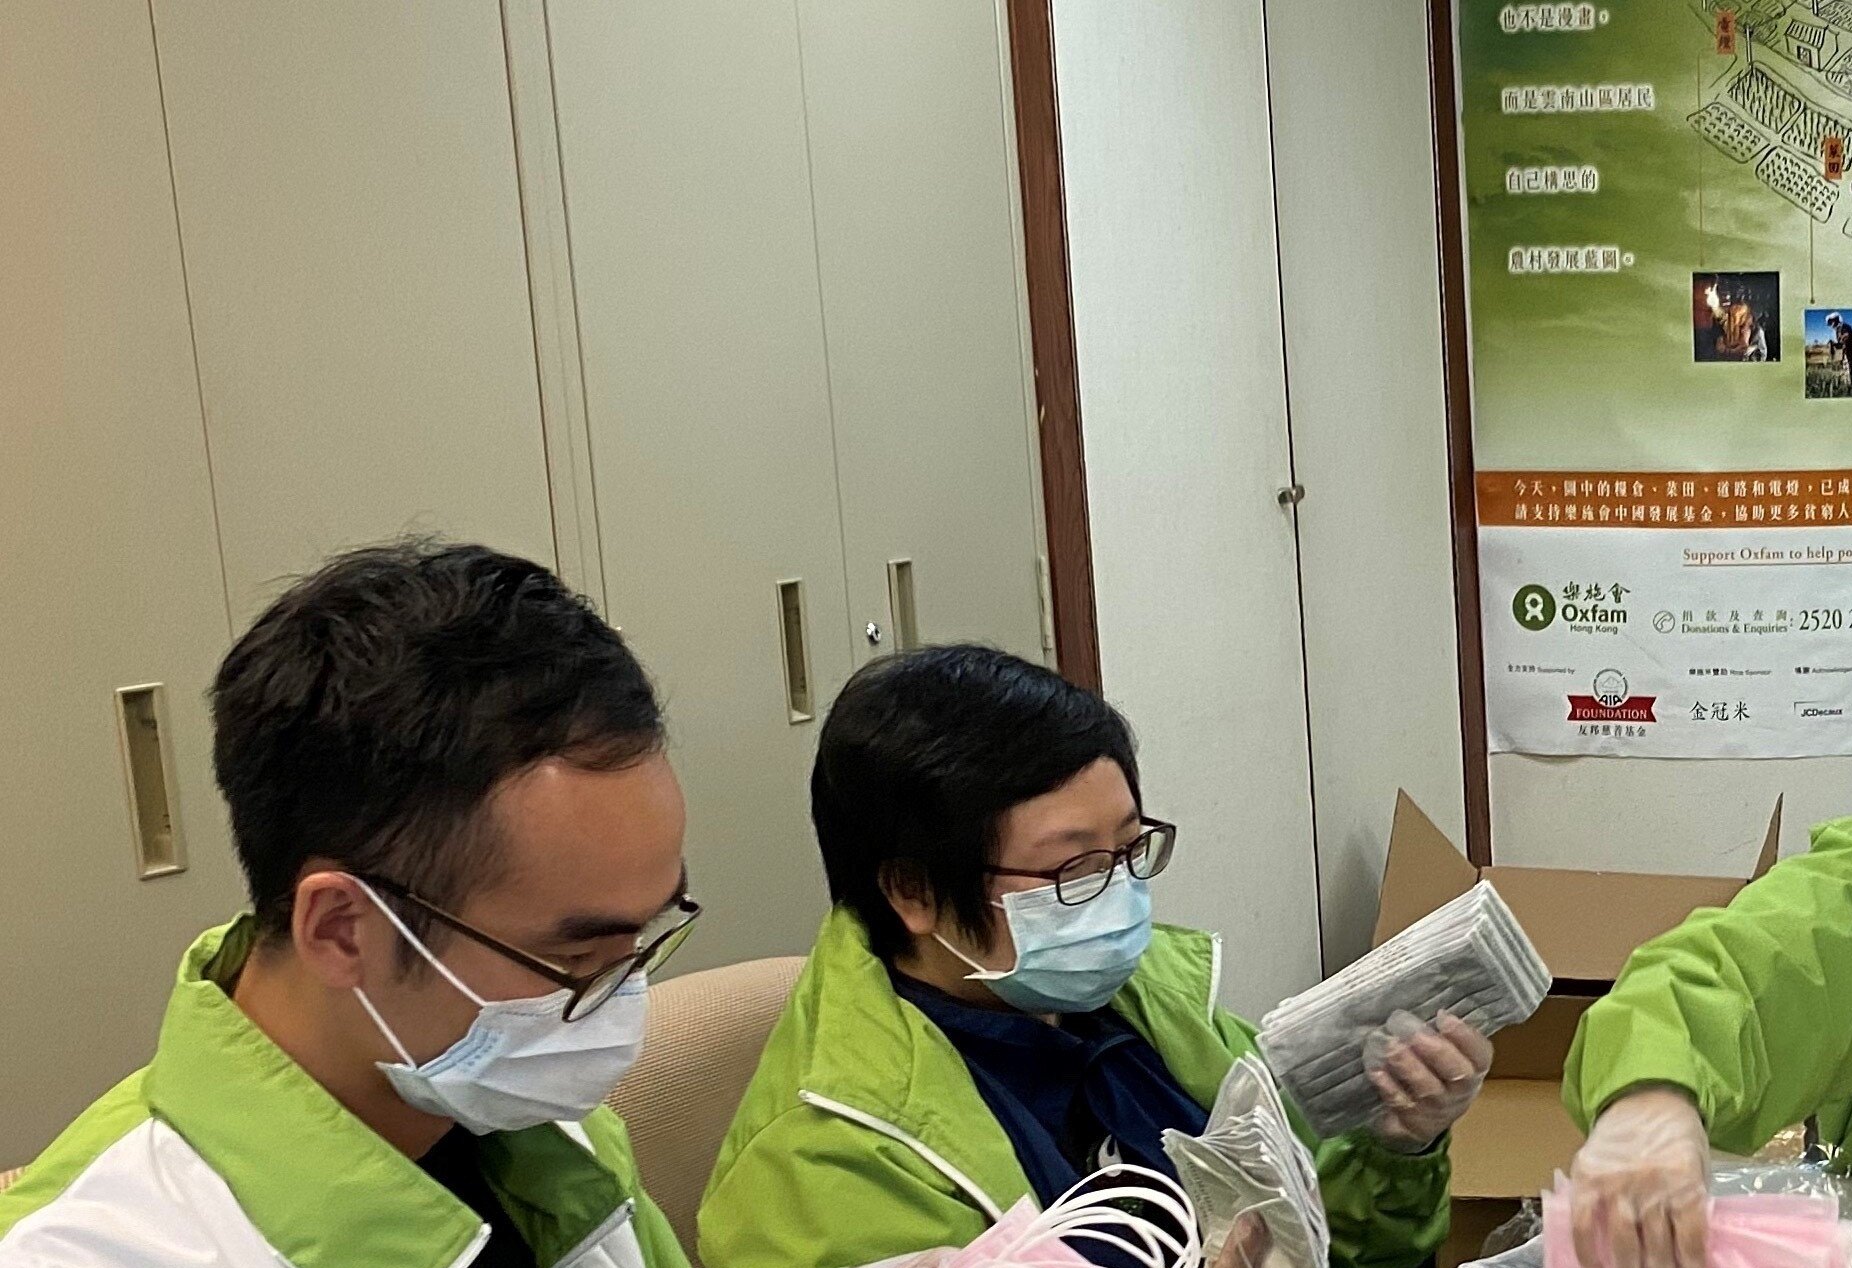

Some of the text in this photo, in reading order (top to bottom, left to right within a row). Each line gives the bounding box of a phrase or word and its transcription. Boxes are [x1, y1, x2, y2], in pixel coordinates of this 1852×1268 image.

[1504, 86, 1654, 112] 而是雲南山區居民
[1508, 167, 1598, 191] 自己構思的
[1683, 548, 1735, 565] Support
[1740, 547, 1784, 561] Oxfam
[1789, 548, 1801, 559] to
[1807, 546, 1834, 562] help
[1562, 581, 1631, 603] 樂施會
[1561, 602, 1628, 624] Oxfam
[1799, 608, 1842, 631] 2520
[1570, 624, 1618, 635] Hong Kong
[1681, 623, 1788, 635] Donations & Enquiries
[1576, 708, 1648, 720] FOUNDATION
[1690, 701, 1751, 722] 金冠米
[1801, 707, 1843, 717] JCDecaux
